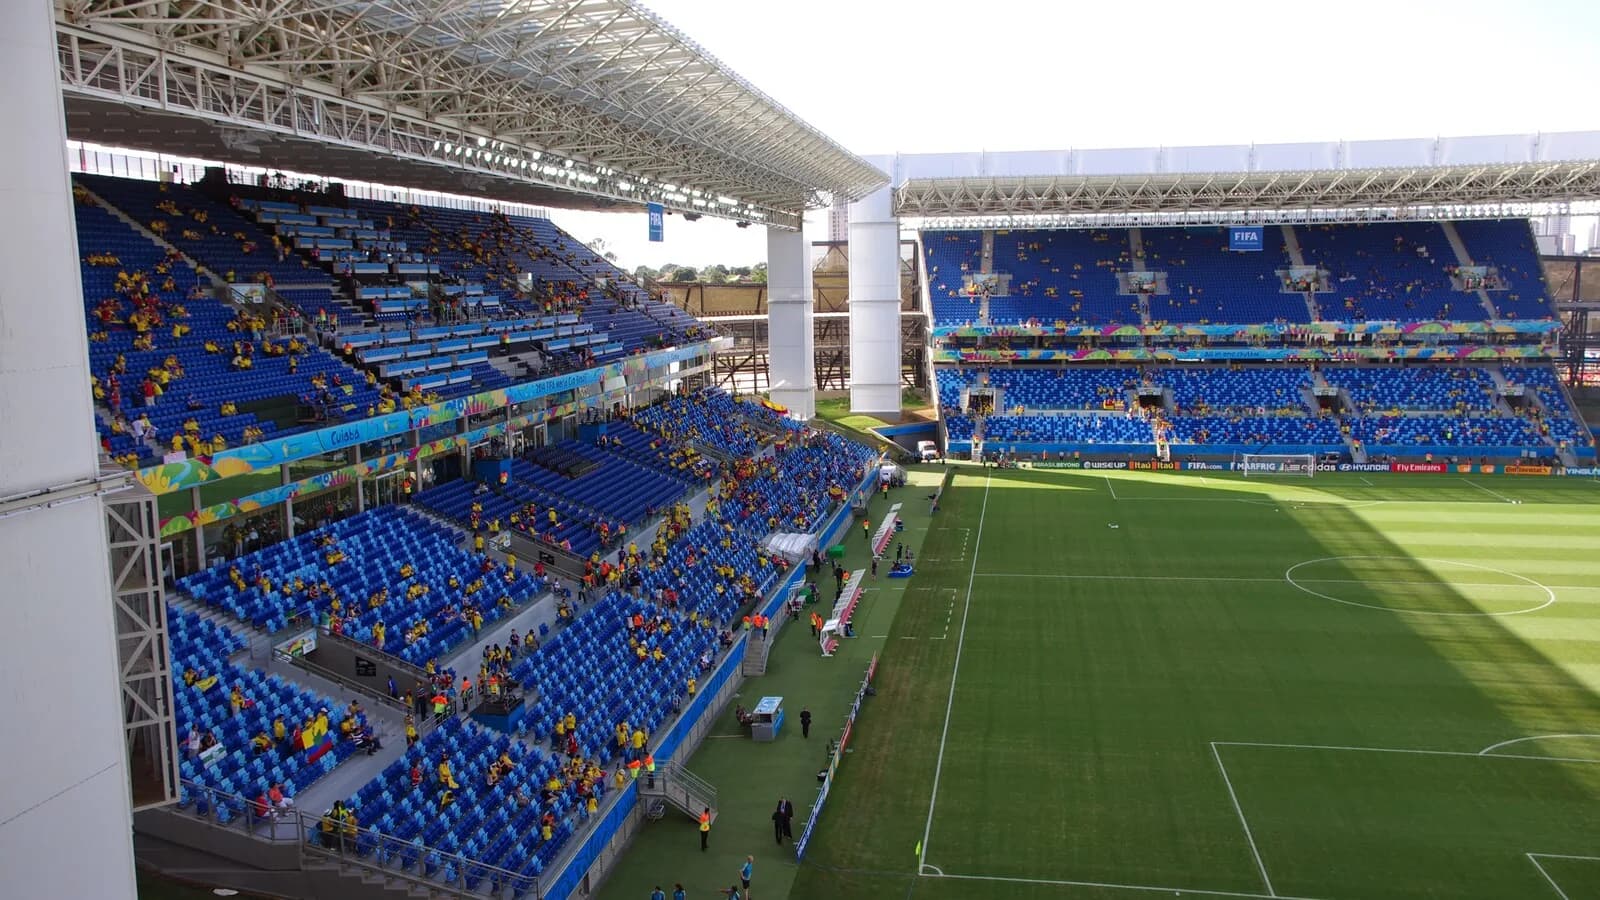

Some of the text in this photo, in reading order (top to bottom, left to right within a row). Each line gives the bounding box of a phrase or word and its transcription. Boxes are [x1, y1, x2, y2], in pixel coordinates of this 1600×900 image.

[1234, 231, 1258, 241] FIFA
[331, 425, 360, 445] Cuiabá
[1237, 463, 1276, 471] MARFRIG
[1353, 464, 1389, 472] HYUNDAI
[1397, 464, 1441, 472] Fly Emirates
